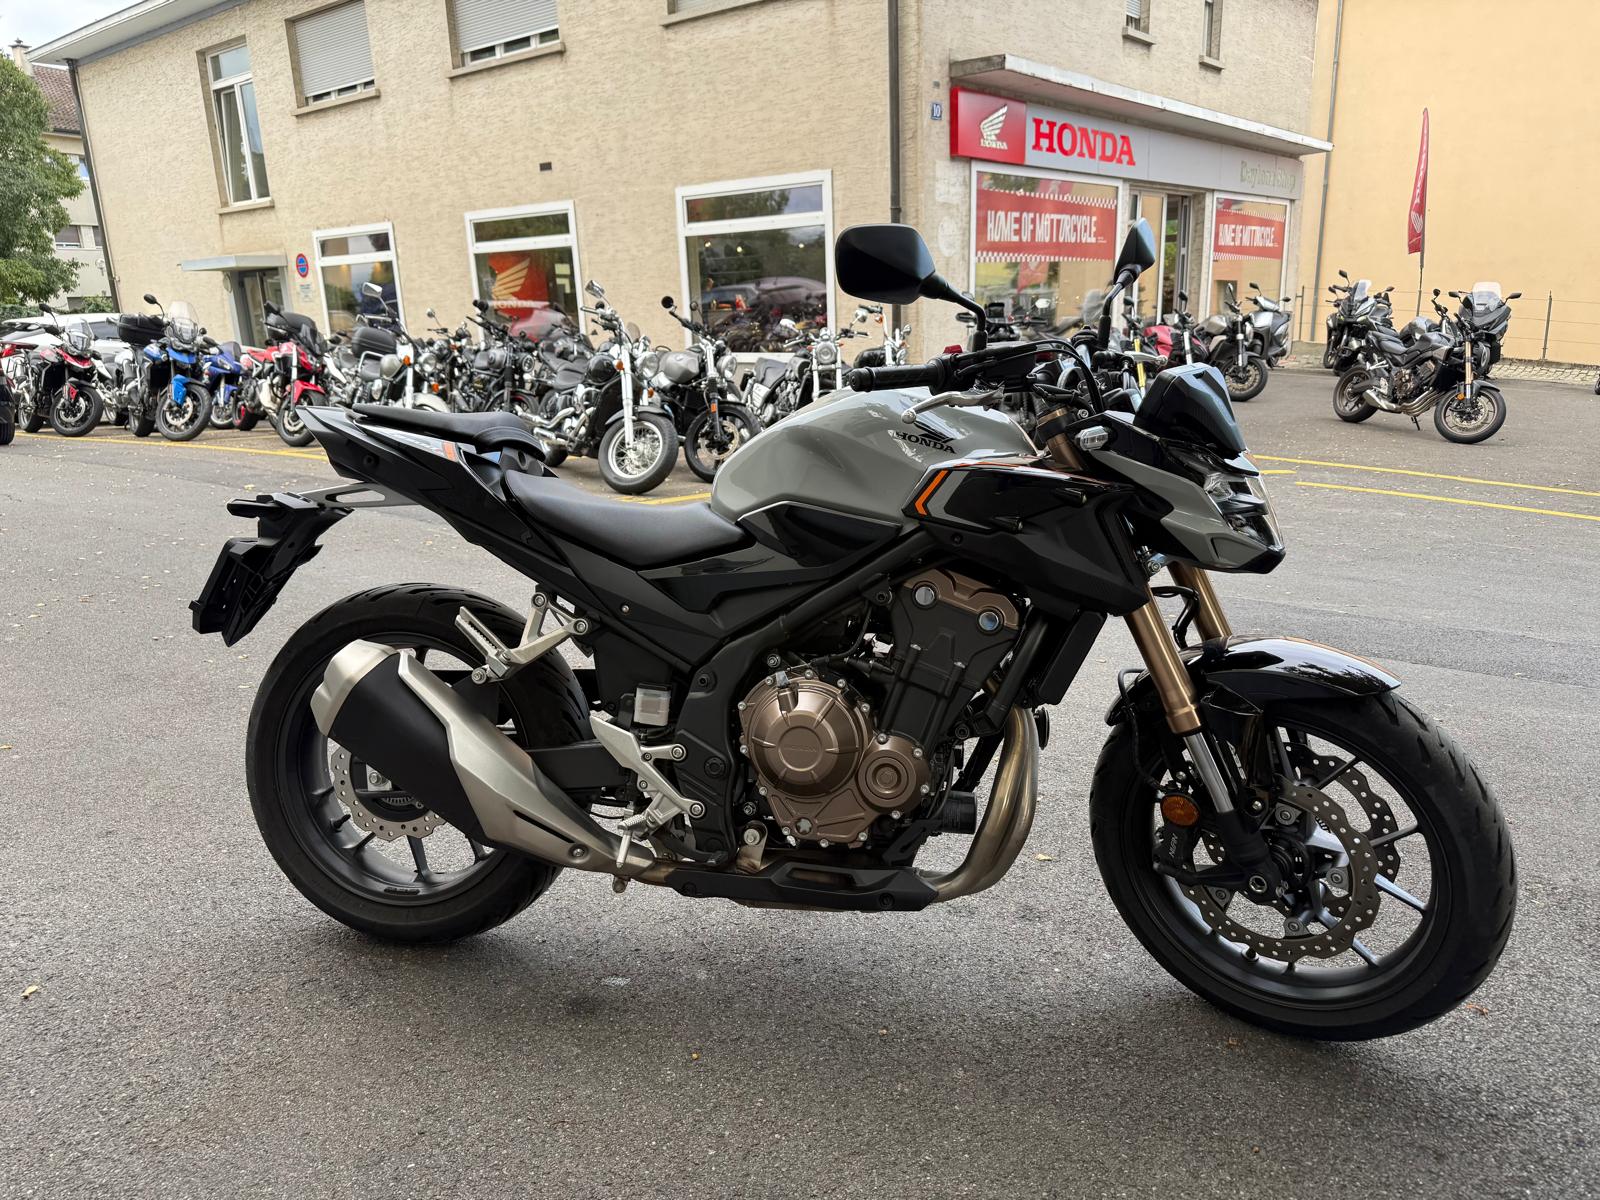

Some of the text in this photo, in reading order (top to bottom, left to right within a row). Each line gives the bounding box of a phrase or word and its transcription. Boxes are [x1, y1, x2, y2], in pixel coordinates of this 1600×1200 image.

[933, 103, 941, 117] 10
[980, 138, 1008, 150] HONDA
[1032, 117, 1136, 166] HONDA
[987, 210, 1020, 242] HOME
[1021, 211, 1034, 243] OF
[896, 431, 957, 454] HONDA
